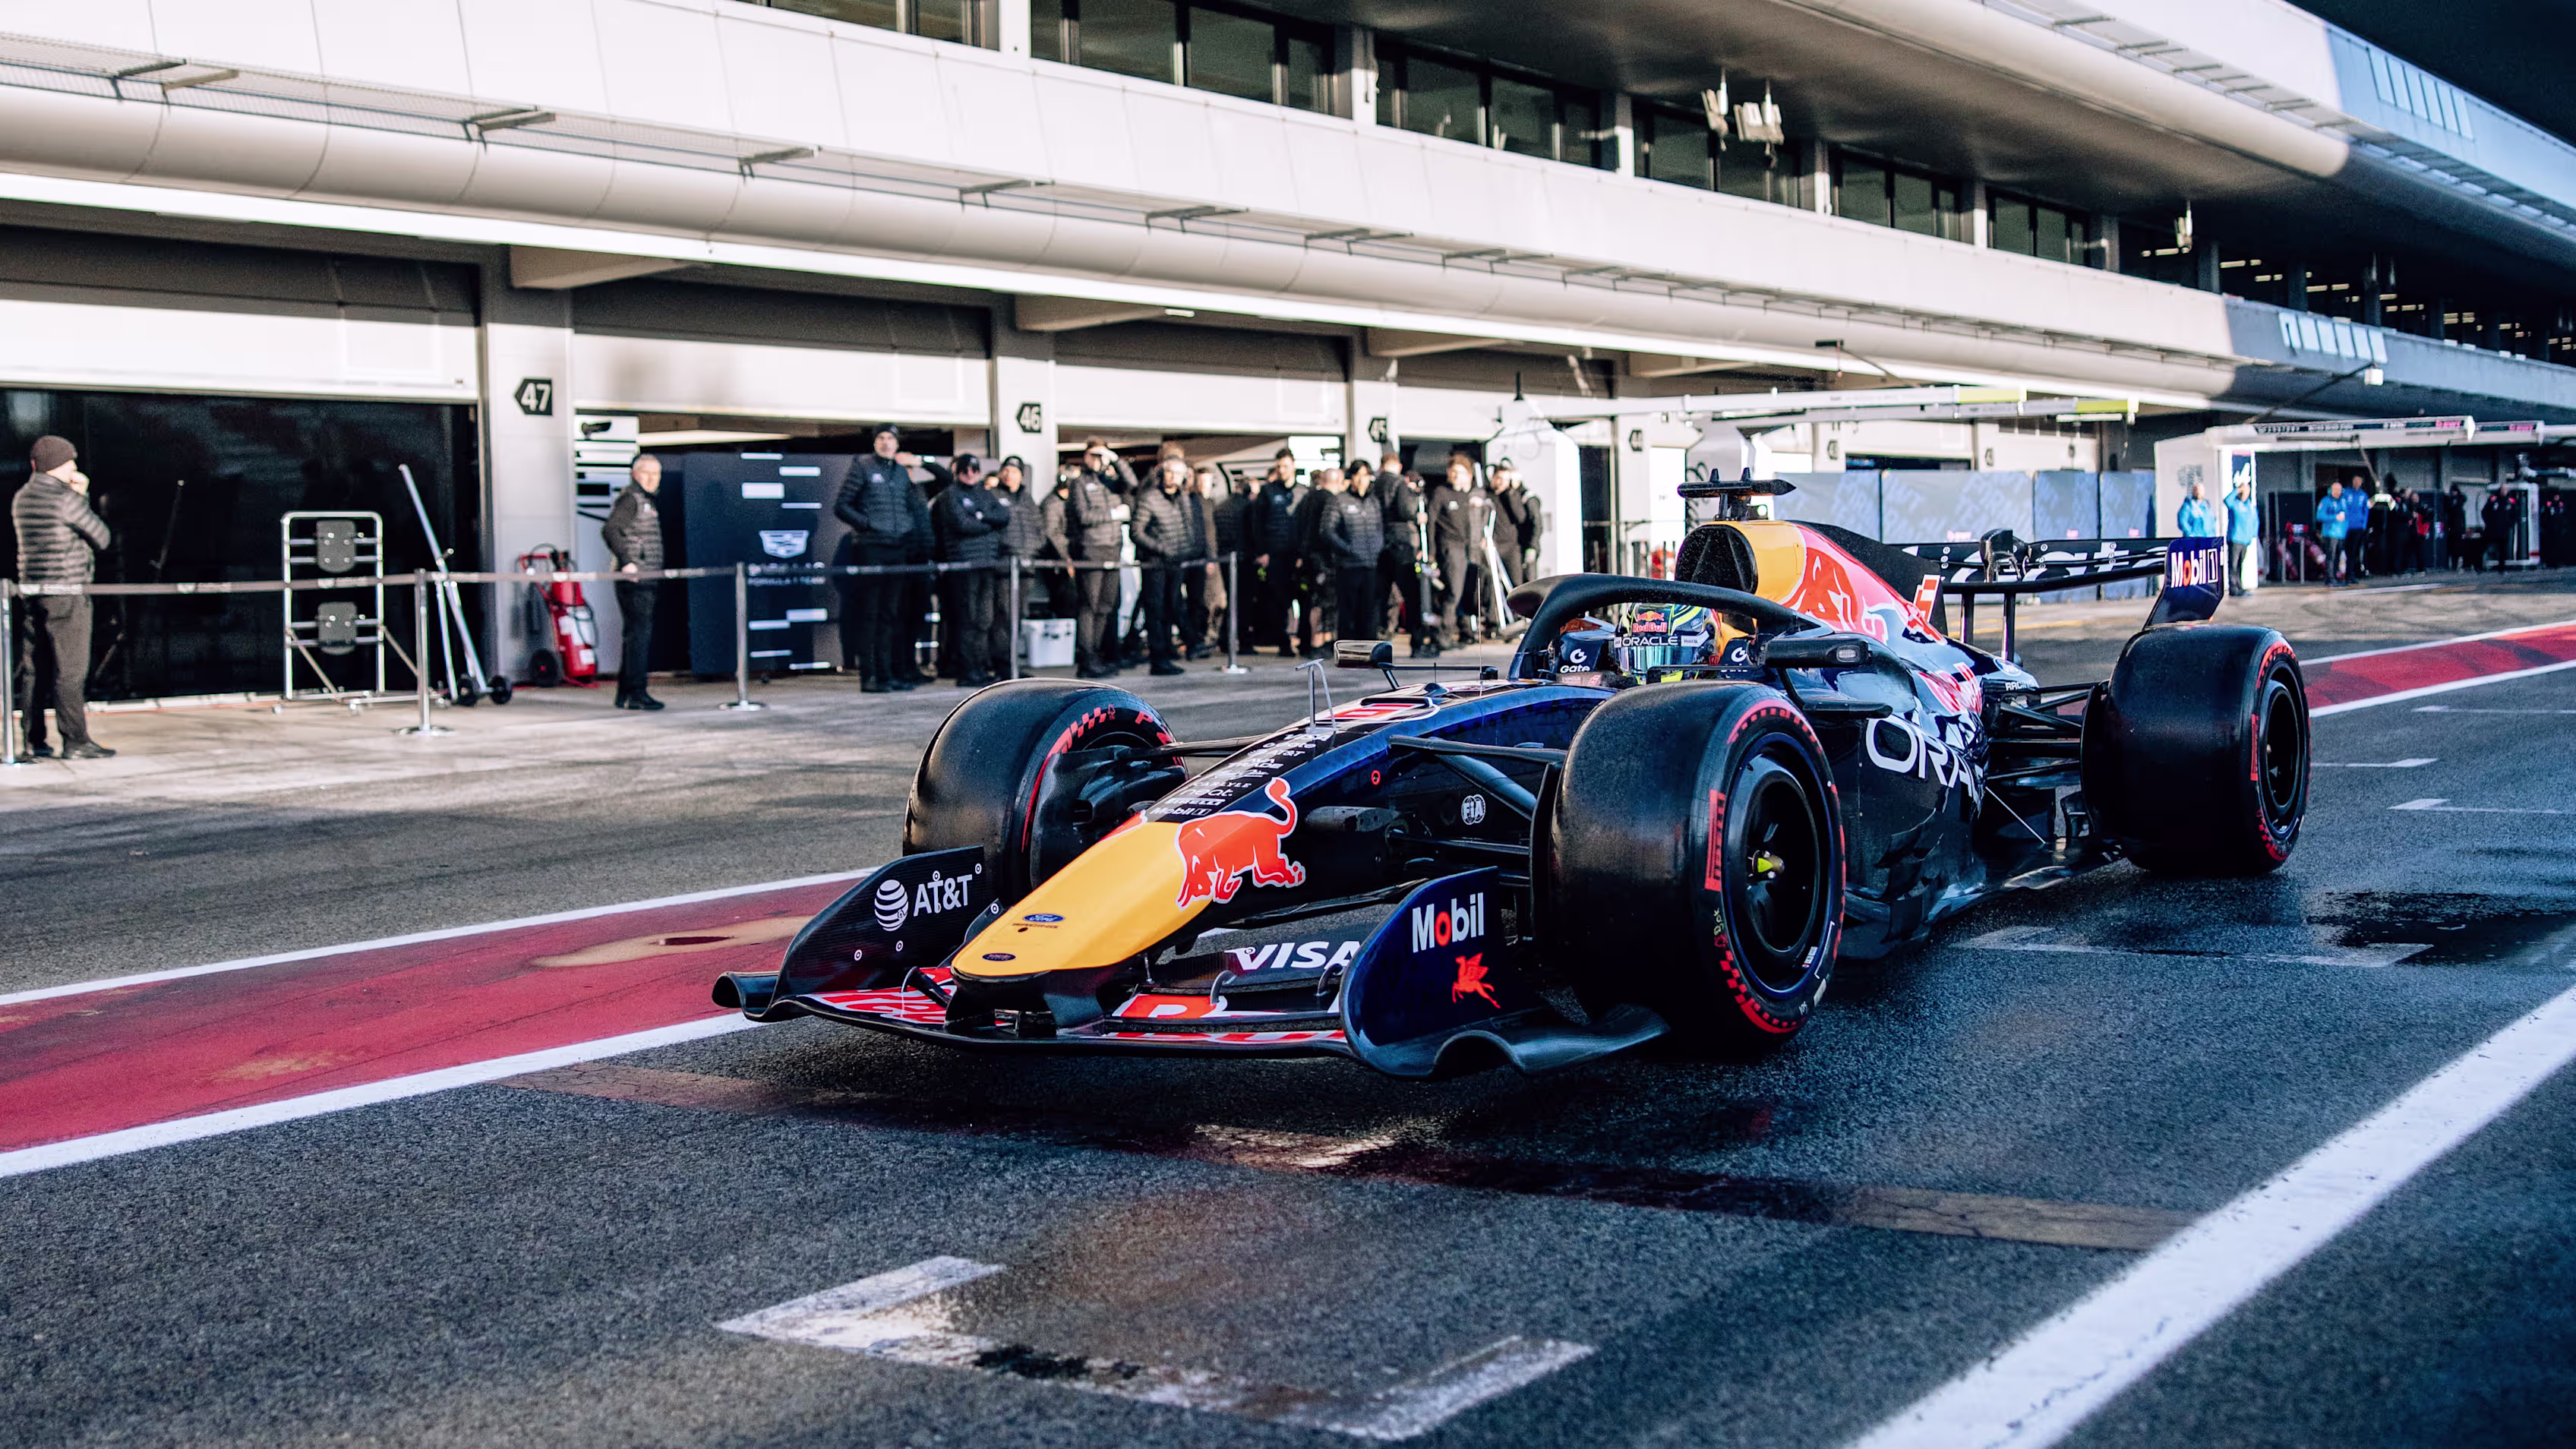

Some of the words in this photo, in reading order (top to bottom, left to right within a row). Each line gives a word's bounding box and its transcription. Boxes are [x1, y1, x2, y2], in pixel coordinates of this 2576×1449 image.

[521, 383, 551, 411] 47
[1020, 406, 1040, 431] 46
[2171, 550, 2206, 588] Mobil
[1622, 636, 1678, 646] ORACLE
[1633, 622, 1647, 633] Red
[1649, 622, 1667, 633] Bull
[1560, 665, 1590, 674] Gate
[914, 874, 972, 917] AT&T
[1413, 892, 1484, 953] Mobil
[1224, 941, 1362, 971] VISA
